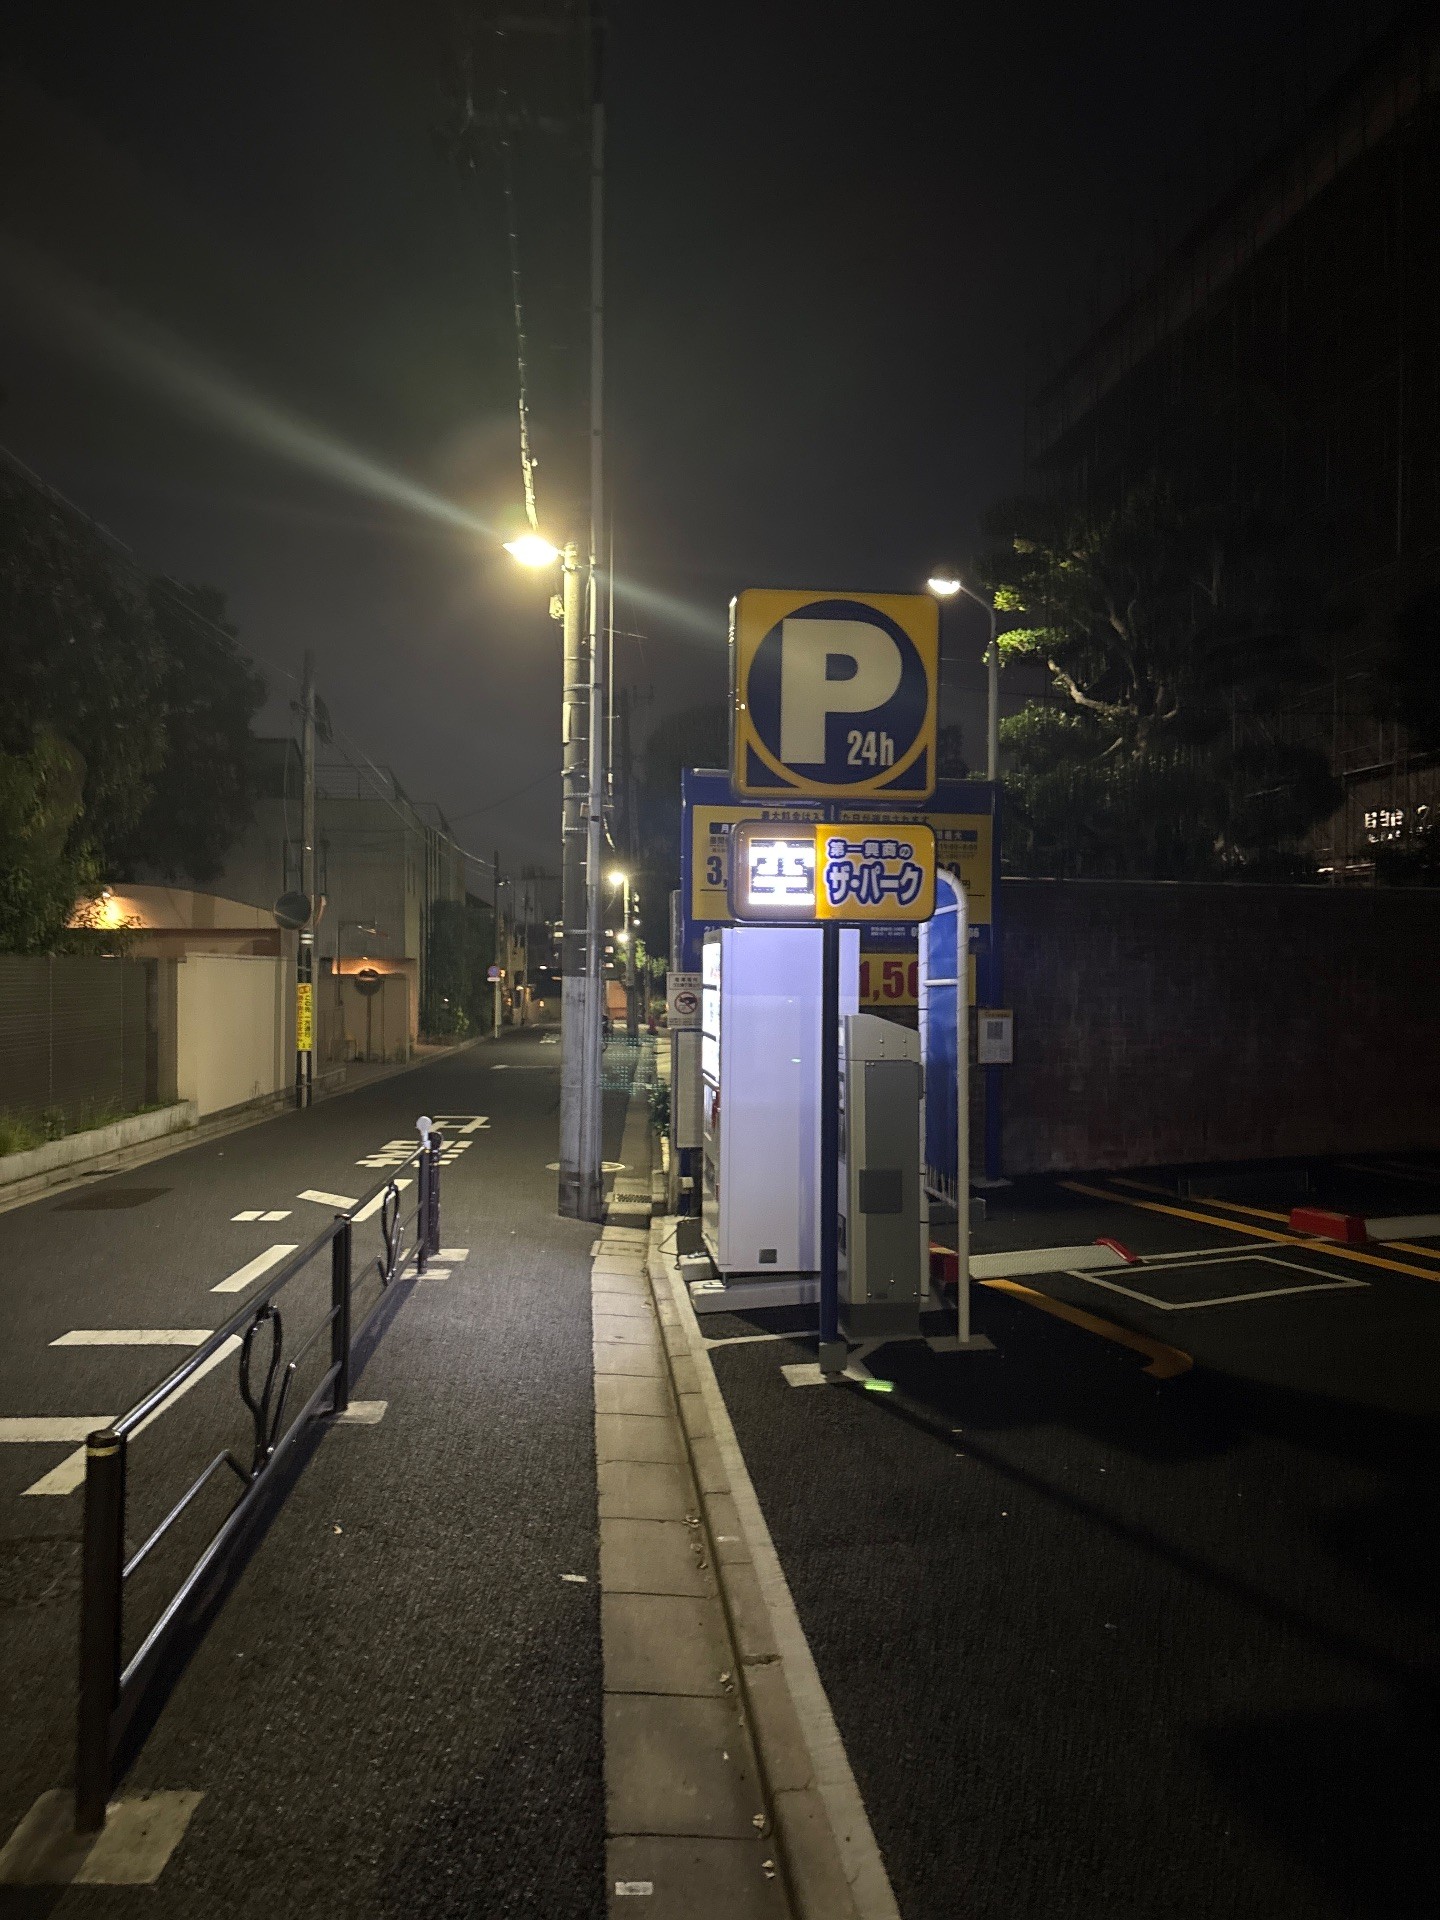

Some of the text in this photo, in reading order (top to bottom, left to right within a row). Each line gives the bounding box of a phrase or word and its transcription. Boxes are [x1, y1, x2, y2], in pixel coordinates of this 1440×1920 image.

[780, 618, 903, 765] P
[846, 730, 895, 767] 24h
[749, 841, 815, 904] 空
[826, 861, 923, 905] ザ・パーク
